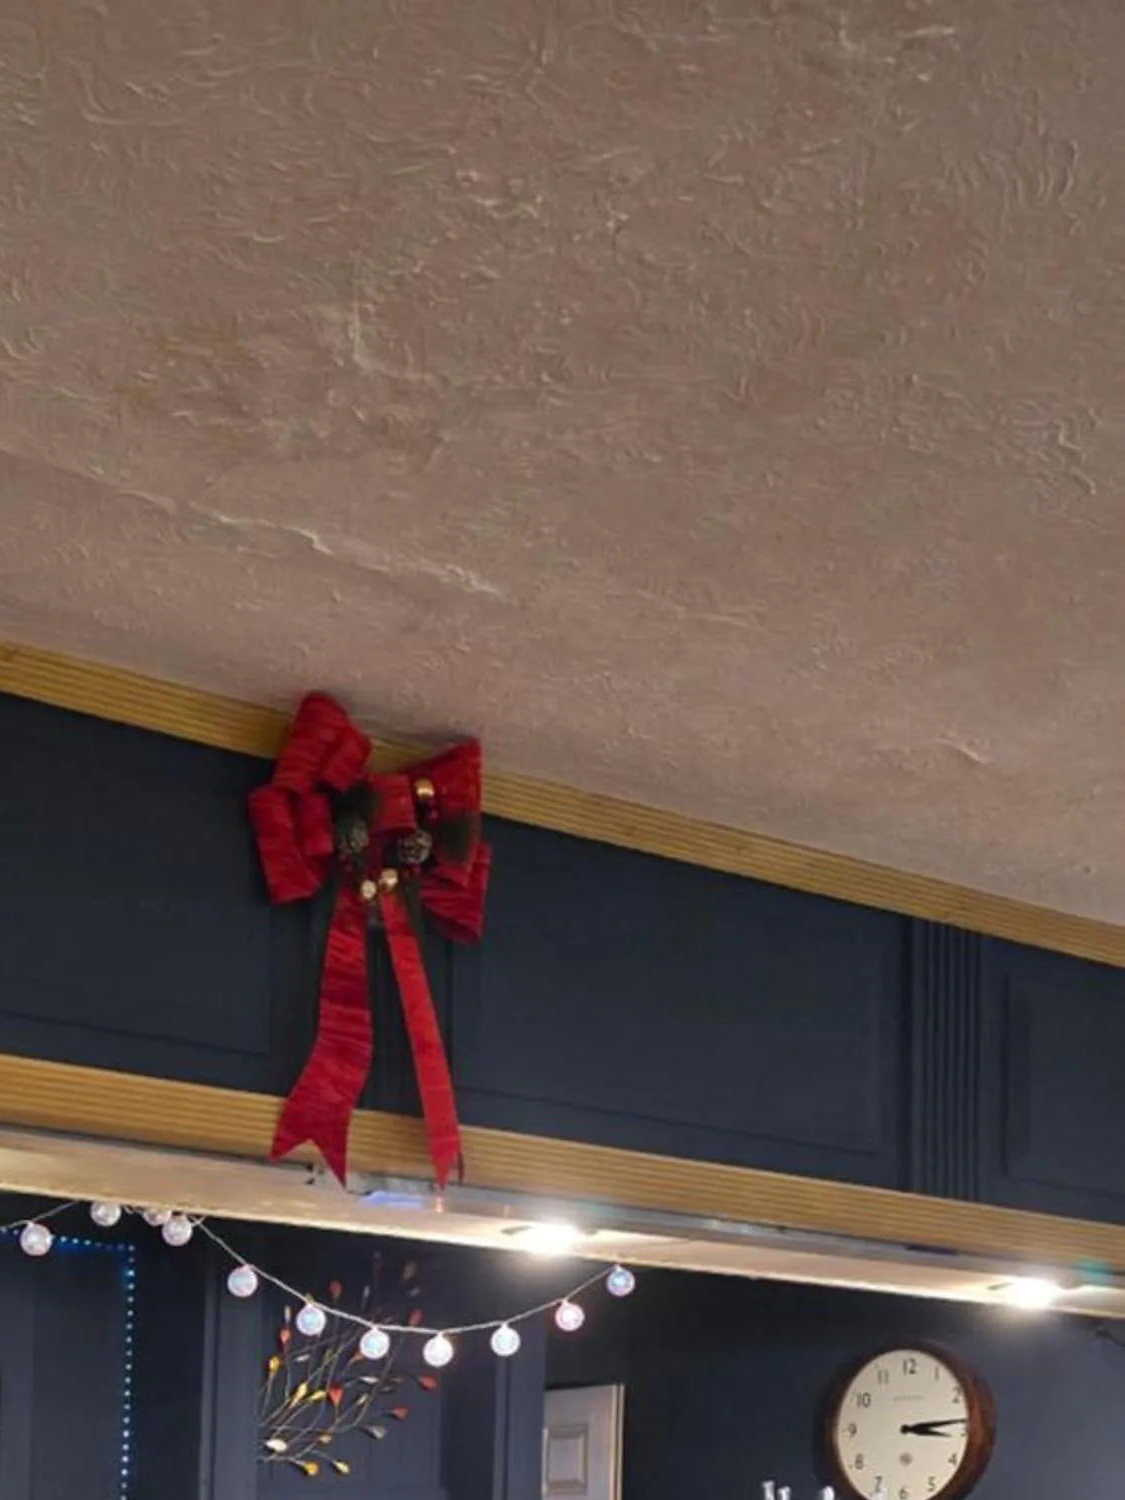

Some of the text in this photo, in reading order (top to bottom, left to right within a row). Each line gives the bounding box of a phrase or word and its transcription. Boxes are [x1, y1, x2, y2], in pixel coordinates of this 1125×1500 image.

[902, 1358, 917, 1375] 12
[877, 1369, 889, 1384] 11
[856, 1392, 871, 1408] 10
[848, 1423, 857, 1437] 9
[855, 1453, 864, 1470] 8
[927, 1476, 936, 1492] 5
[899, 1486, 909, 1500] 6
